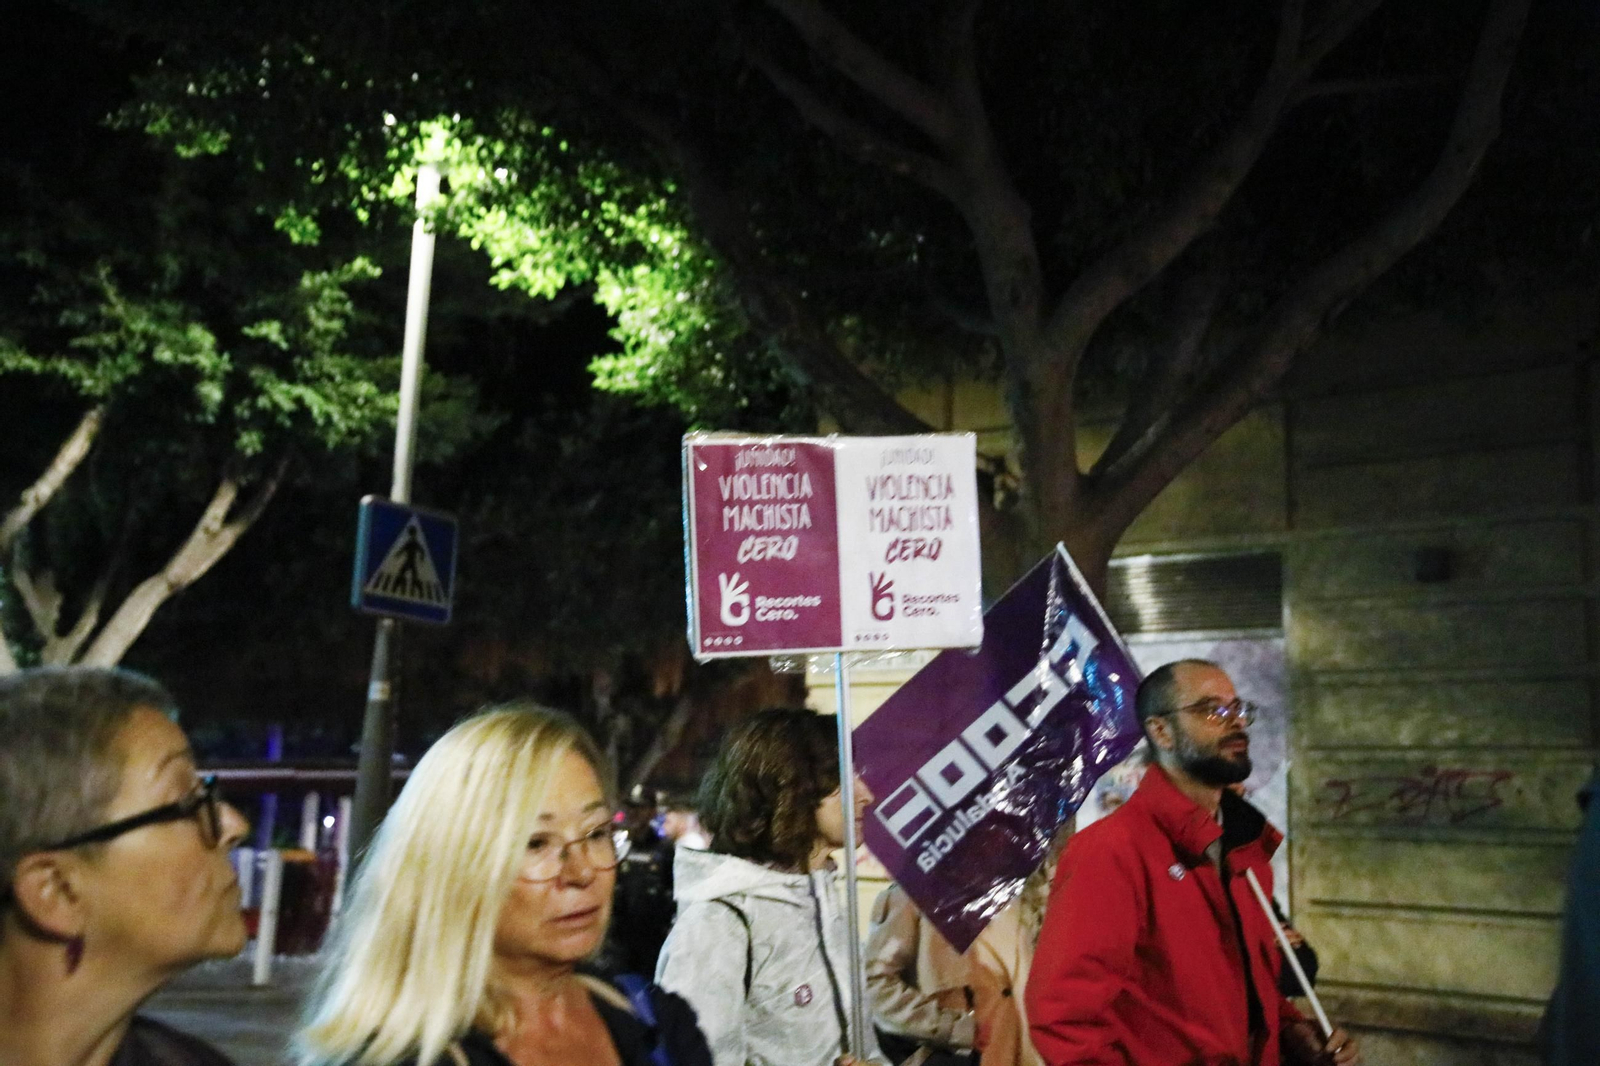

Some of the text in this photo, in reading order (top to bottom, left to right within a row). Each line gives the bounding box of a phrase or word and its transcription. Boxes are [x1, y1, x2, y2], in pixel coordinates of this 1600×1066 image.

[718, 471, 813, 501] VIOLENCIA
[865, 472, 956, 501] VIOLENCIA
[722, 502, 812, 532] MACHISTA
[868, 504, 955, 533] MACHISTA
[737, 534, 799, 564] CERO
[885, 537, 943, 564] CERO
[755, 594, 821, 609] Recortes
